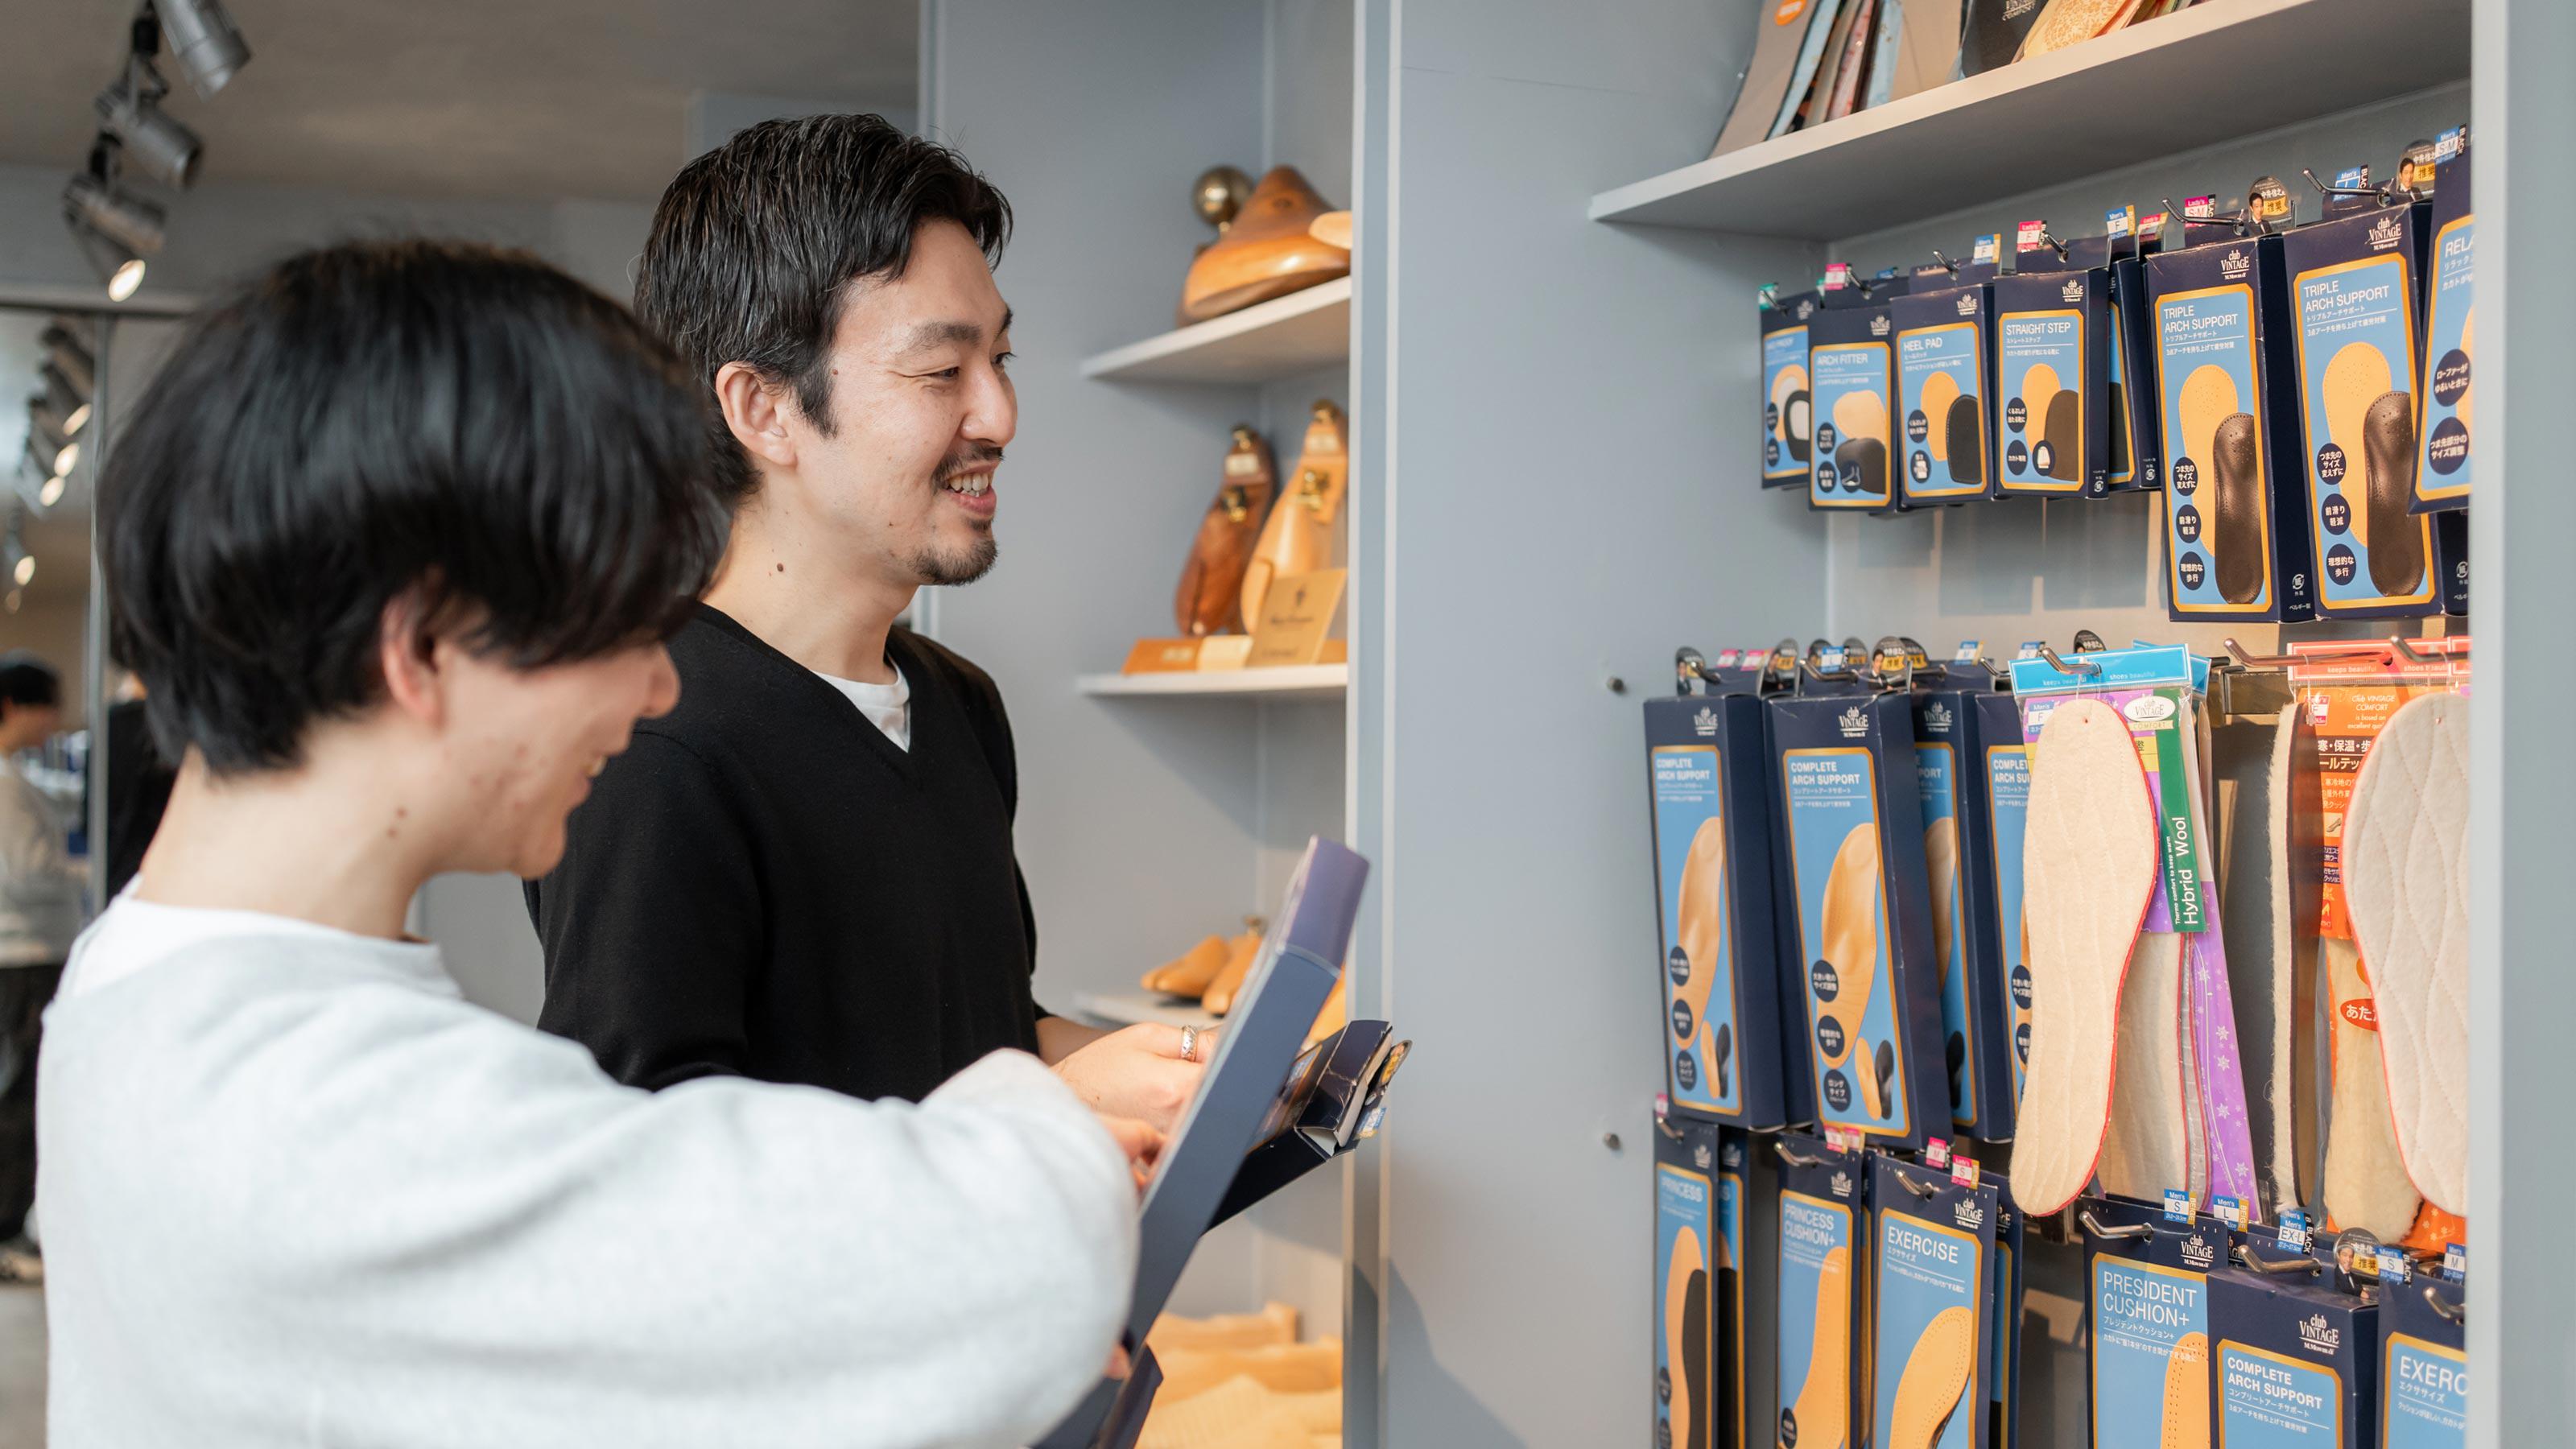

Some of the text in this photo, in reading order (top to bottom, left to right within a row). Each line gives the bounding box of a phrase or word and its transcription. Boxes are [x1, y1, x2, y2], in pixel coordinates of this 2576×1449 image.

[2368, 223, 2402, 242] VINTAGE
[2221, 256, 2250, 271] VINTAGE
[2304, 280, 2339, 298] TRIPLE
[2306, 285, 2390, 313] ARCH SUPPORT
[2164, 305, 2194, 320] TRIPLE
[2006, 322, 2070, 336] STRAIGHT STEP
[2165, 313, 2239, 333] ARCH SUPPORT
[1903, 337, 1942, 352] HEEL PAD
[1817, 355, 1839, 365] ARCH
[2319, 452, 2343, 460] つま先の
[2175, 464, 2195, 473] つま先の
[2323, 460, 2340, 469] サイズ
[2178, 473, 2194, 481] サイズ
[2321, 468, 2344, 478] 変えずに
[2335, 567, 2349, 577] 歩行
[2368, 695, 2396, 703] VINTAGE
[2135, 705, 2165, 716] VINTAGE
[1839, 714, 1868, 729] VINTAGE
[1657, 758, 1693, 769] COMPLETE
[1791, 762, 1837, 773] COMPLETE
[1993, 758, 2028, 770] COMPLET
[1677, 770, 1710, 780] SUPPORT
[1793, 774, 1860, 785] ARCH SUPPORT
[1918, 768, 1942, 778] PORT
[1995, 773, 2015, 783] ARCH
[2172, 817, 2198, 925] Hybrid Wool
[2346, 1004, 2376, 1022] あた
[2169, 1191, 2186, 1200] Men's
[2174, 1201, 2180, 1212] S
[2217, 1198, 2235, 1208] Men's
[1785, 1203, 1835, 1231] PRINCESS
[1955, 1203, 1984, 1222] VINTAGE
[2223, 1208, 2229, 1219] L
[2285, 1220, 2301, 1230] Men's
[1785, 1221, 1835, 1247] CUSHION+
[2190, 1234, 2203, 1246] club
[2303, 1226, 2314, 1254] BLACK
[1888, 1226, 1959, 1264] EXERCISE
[2181, 1241, 2214, 1259] VINTAGE
[2379, 1248, 2400, 1258] Men's
[2388, 1258, 2395, 1270] S
[2403, 1253, 2412, 1285] BLACK
[2451, 1257, 2458, 1268] M
[2103, 1271, 2197, 1308] PRESIDENT
[2103, 1293, 2190, 1327] CUSHION+
[2310, 1314, 2327, 1329] club
[2299, 1320, 2339, 1345] VINTAGE
[2227, 1356, 2292, 1385] COMPLETE
[2400, 1356, 2469, 1396] EXERC
[2227, 1373, 2323, 1410] ARCH SUPPORT
